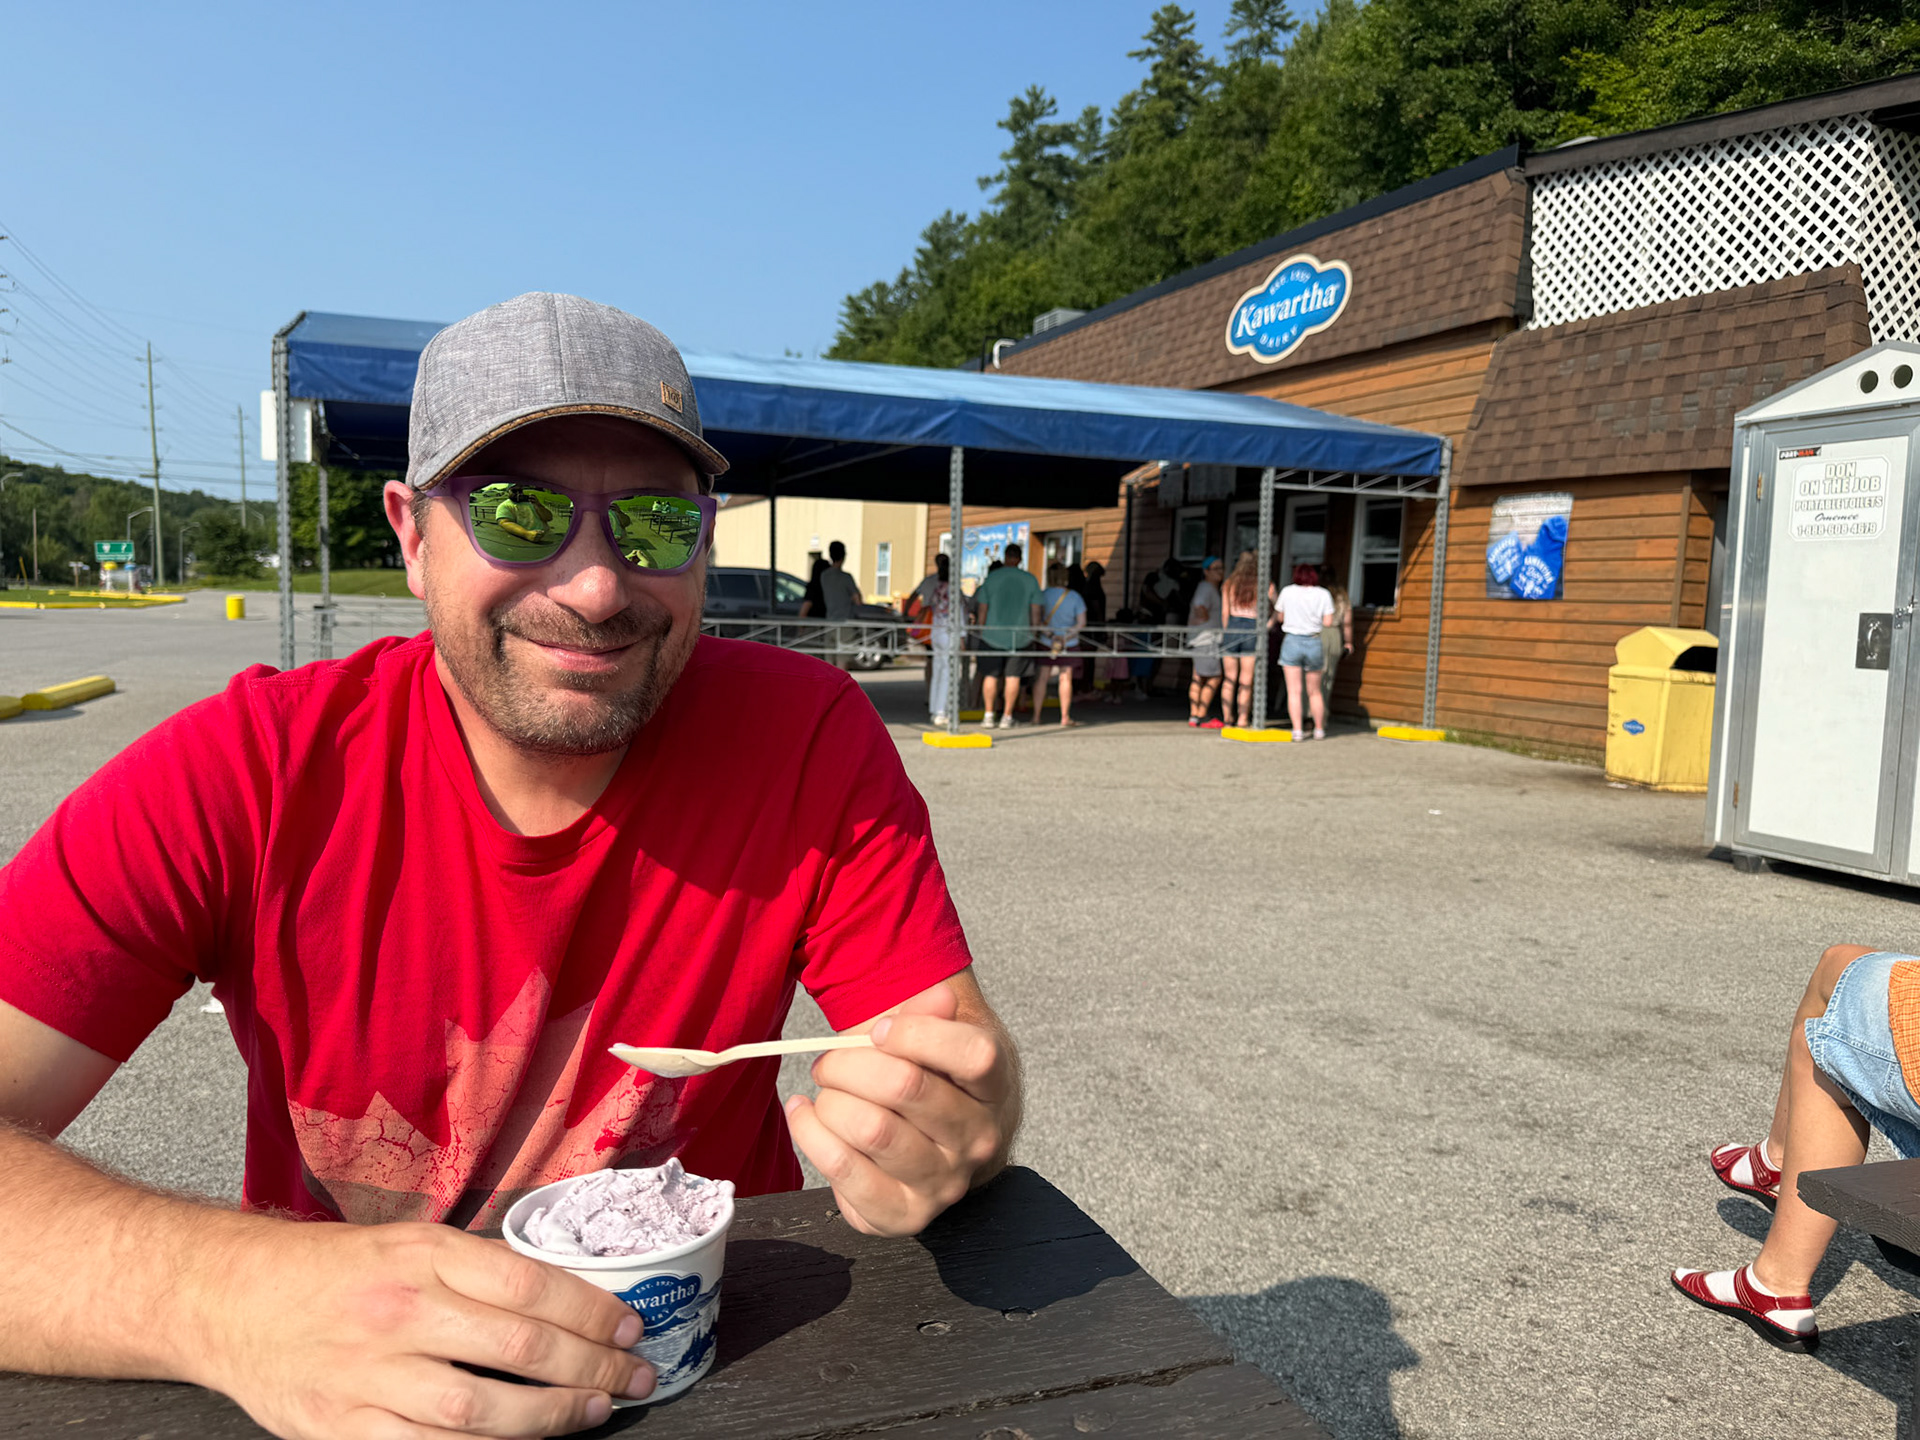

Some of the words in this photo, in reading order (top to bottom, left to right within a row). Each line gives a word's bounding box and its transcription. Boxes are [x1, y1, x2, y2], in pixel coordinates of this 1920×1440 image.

[1235, 282, 1337, 339] Kawartha
[1259, 324, 1298, 348] DAIRY
[1825, 462, 1857, 479] DON
[1800, 480, 1819, 496] ON
[1823, 478, 1852, 494] THE
[1852, 476, 1881, 493] JOB
[1795, 498, 1842, 512] PORTABLE
[1842, 496, 1883, 510] TOILETS
[625, 1284, 696, 1310] wartha
[635, 1283, 653, 1294] EST.
[644, 1308, 670, 1322] AIRY
